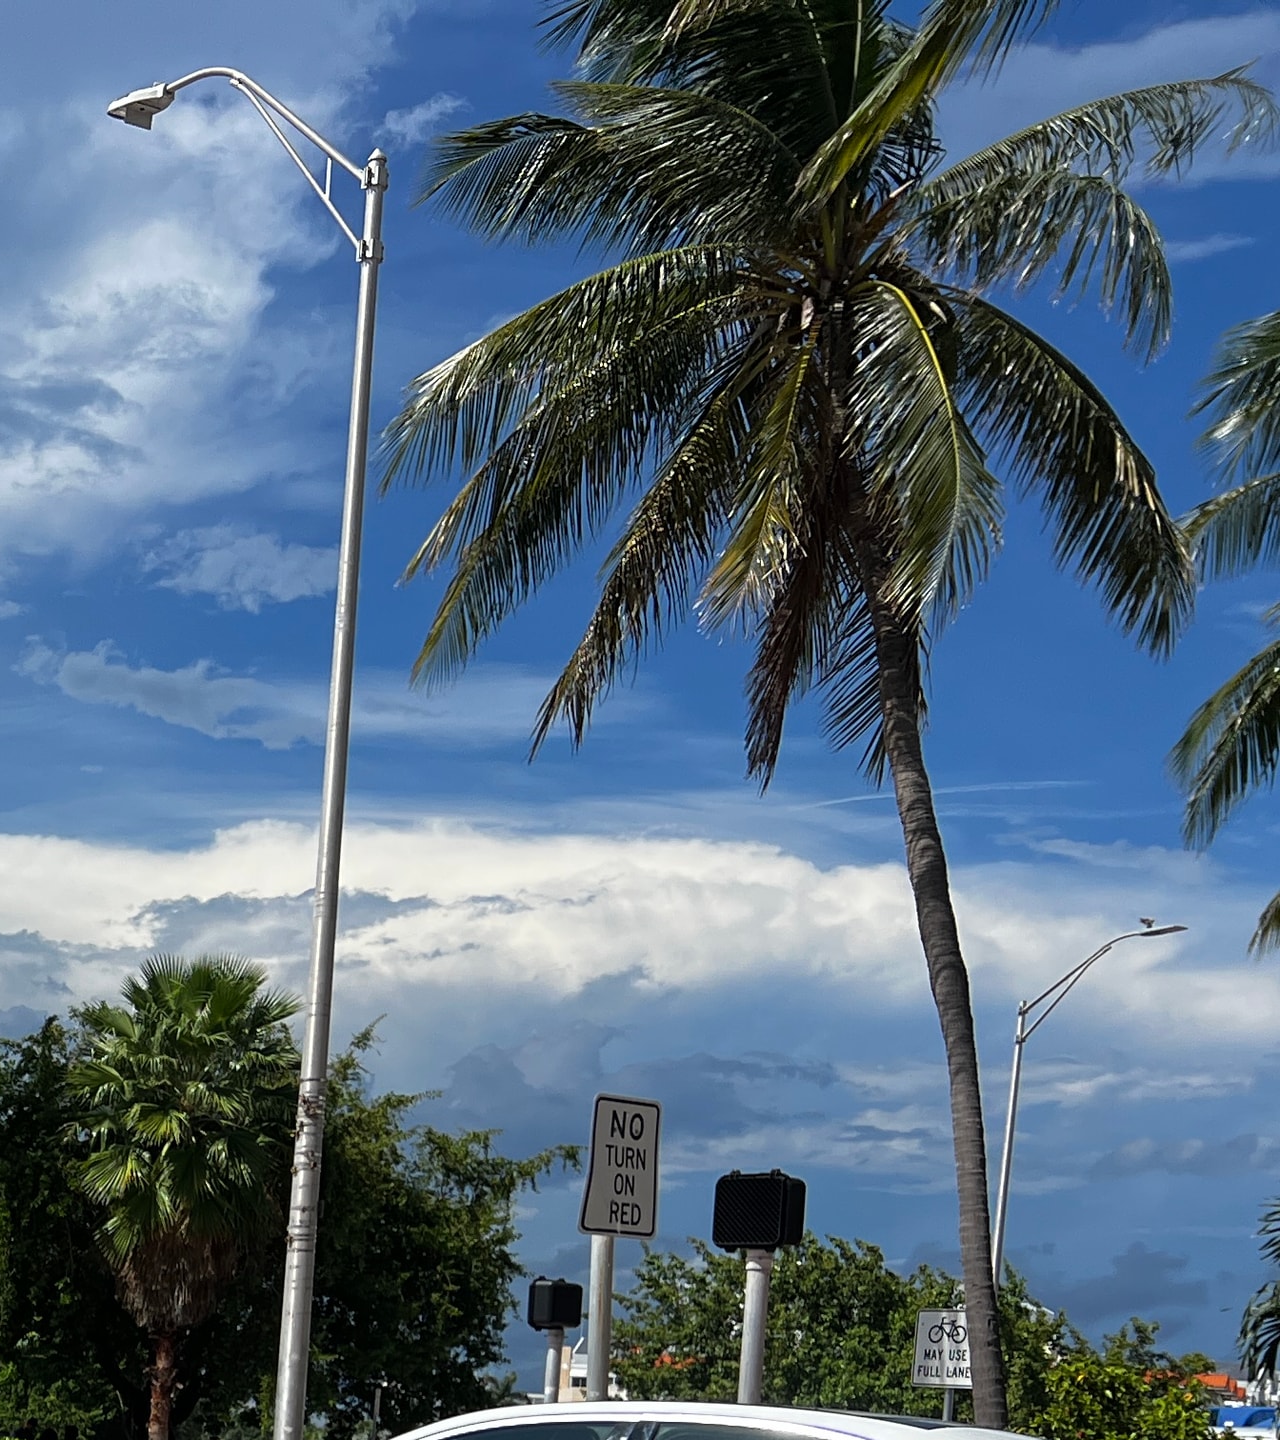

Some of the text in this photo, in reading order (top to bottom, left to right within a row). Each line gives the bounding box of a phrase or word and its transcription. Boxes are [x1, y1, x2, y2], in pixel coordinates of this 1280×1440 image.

[610, 1109, 645, 1141] NO
[605, 1144, 647, 1171] TURN
[613, 1173, 635, 1197] ON
[608, 1200, 642, 1226] RED
[923, 1348, 968, 1361] MAY USE
[917, 1365, 972, 1378] FULL LANE
